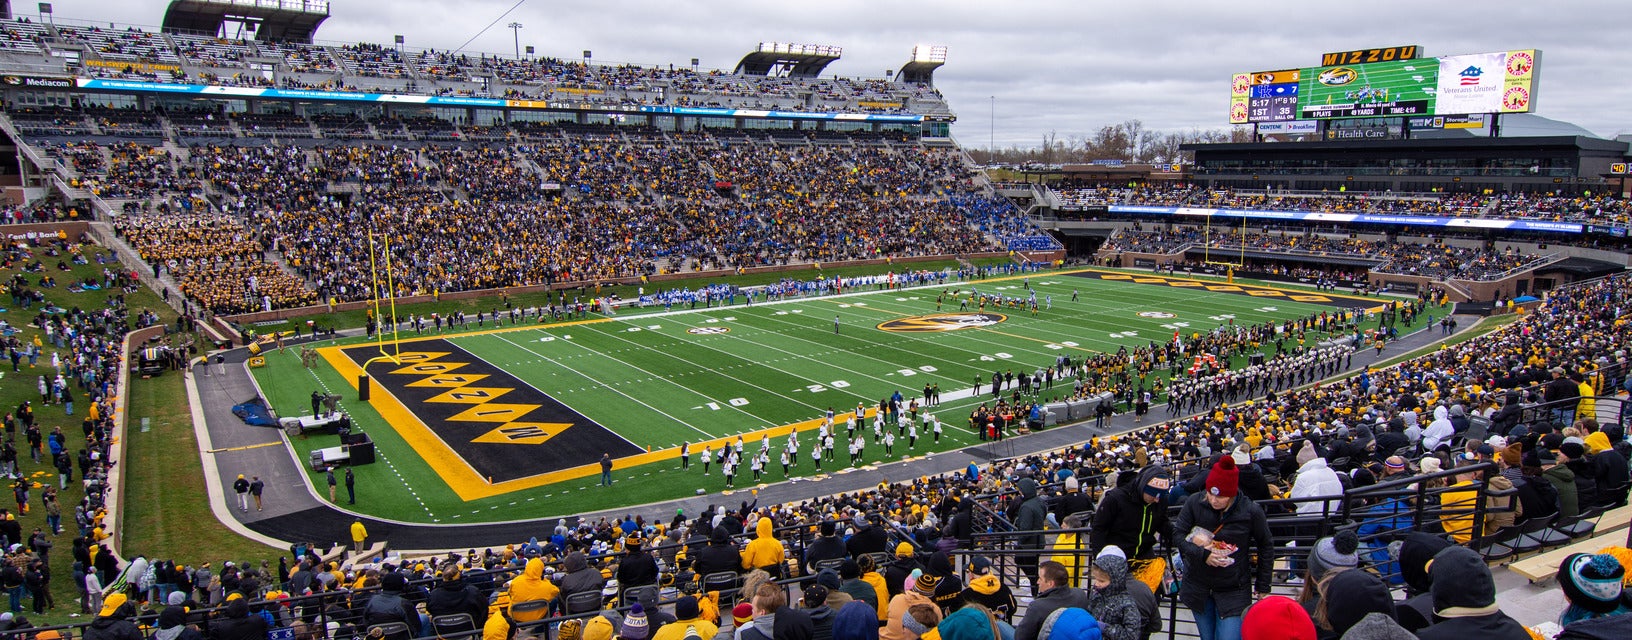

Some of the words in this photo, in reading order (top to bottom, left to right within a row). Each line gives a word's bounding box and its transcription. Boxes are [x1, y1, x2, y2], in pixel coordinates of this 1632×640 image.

[1322, 46, 1415, 66] MIZZOU
[1292, 72, 1298, 80] 3
[26, 78, 70, 87] Mediacom
[1252, 99, 1270, 107] 5:17
[1289, 96, 1297, 104] 10
[1252, 108, 1268, 116] 1ST
[1279, 107, 1290, 115] 35
[1337, 129, 1364, 139] Health
[1365, 129, 1385, 138] Care
[1613, 164, 1625, 173] 40
[39, 230, 60, 239] Bank
[979, 352, 1014, 362] 40
[897, 365, 939, 377] 30
[806, 380, 851, 393] 20
[397, 353, 550, 441] MIZZOU
[705, 397, 750, 411] 10
[987, 579, 995, 587] M
